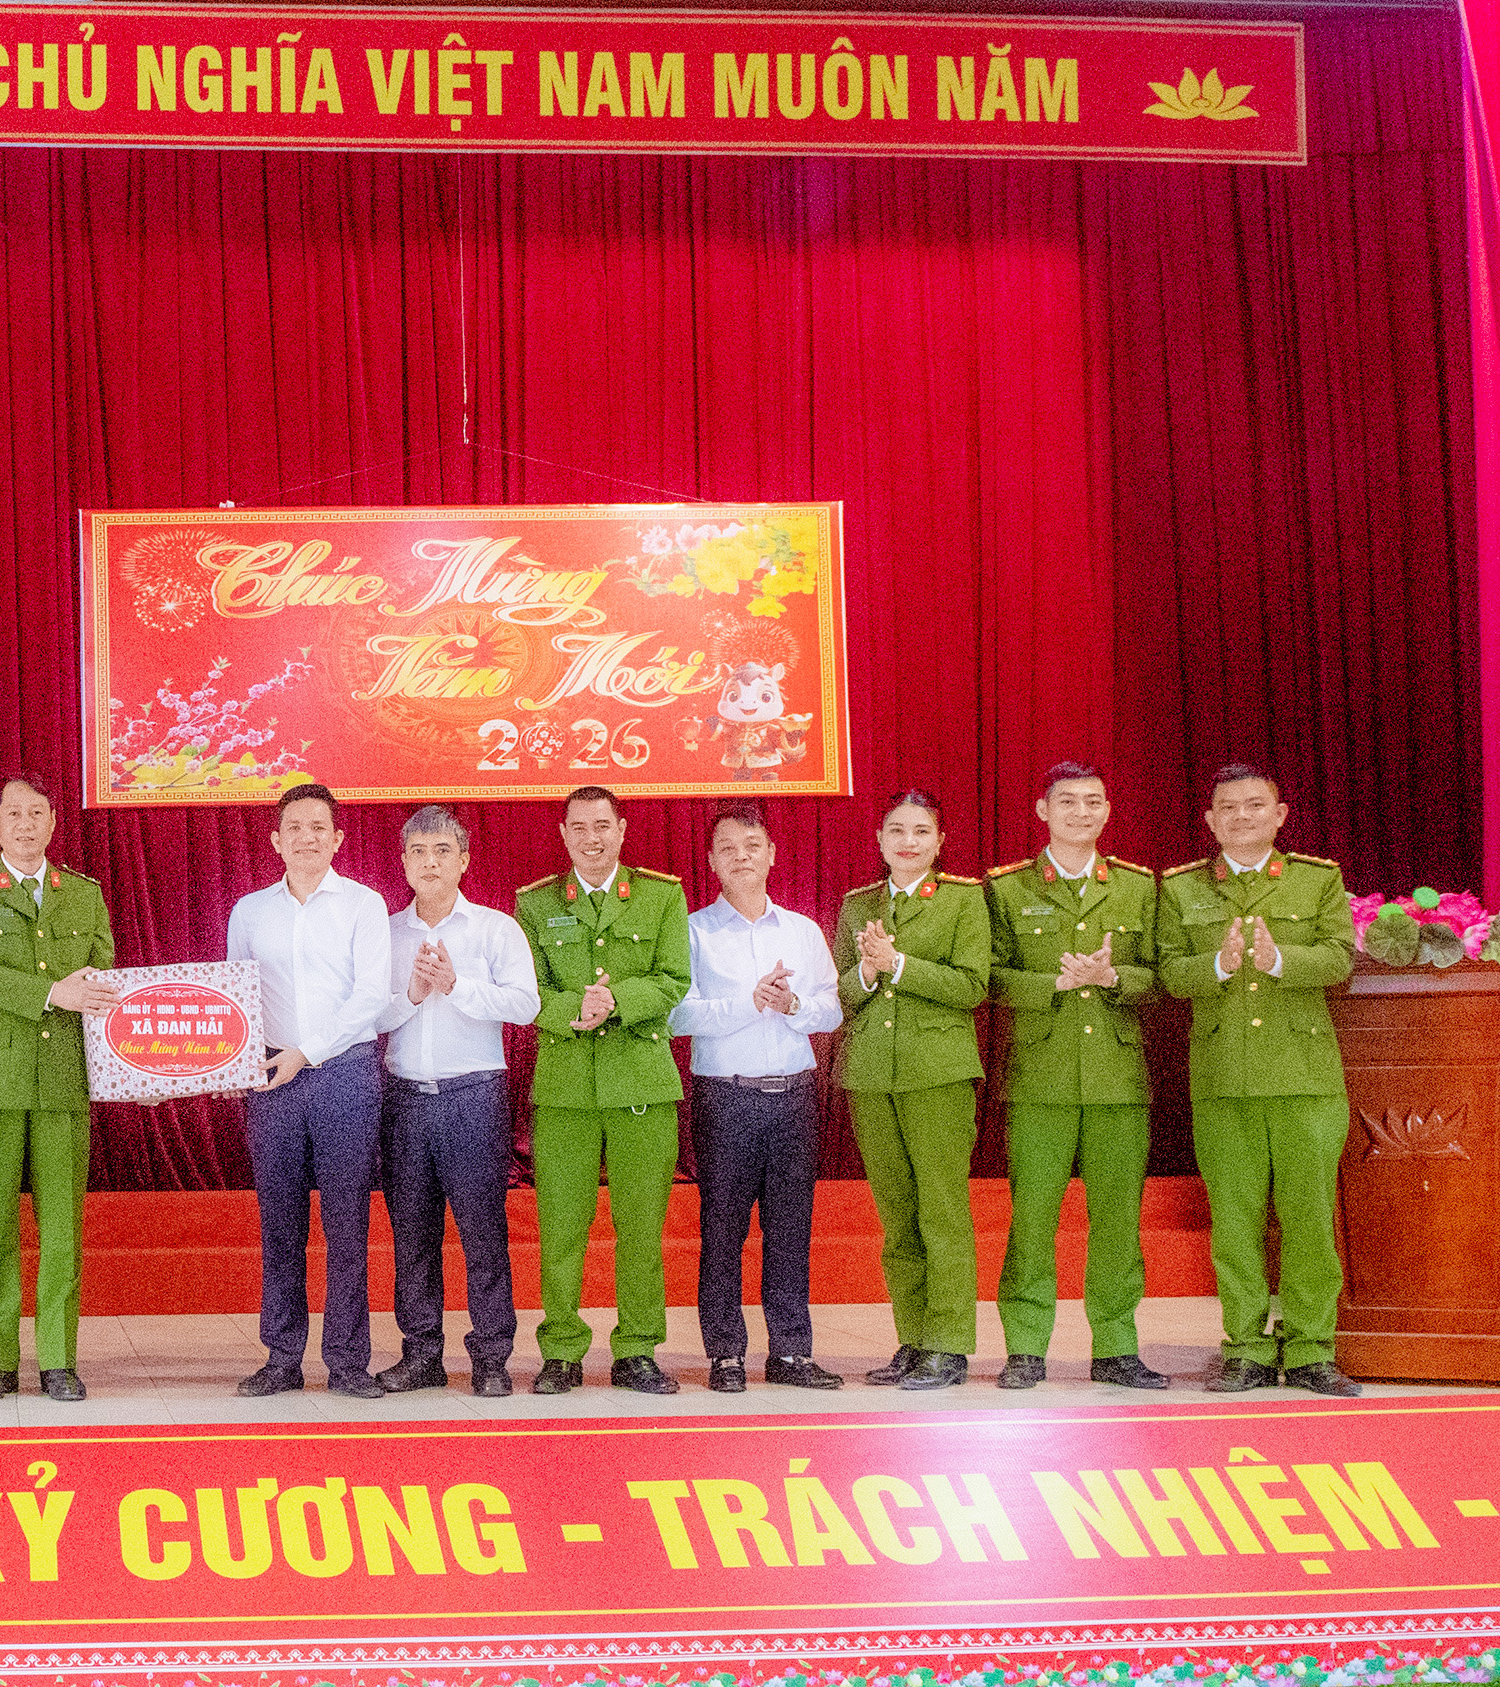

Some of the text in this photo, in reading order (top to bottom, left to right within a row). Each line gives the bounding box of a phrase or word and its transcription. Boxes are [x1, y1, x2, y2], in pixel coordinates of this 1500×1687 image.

[136, 32, 344, 114] NGHĨA
[365, 32, 514, 132] VIỆT
[539, 51, 685, 118] NAM
[713, 37, 909, 120] MUÔN
[936, 43, 1080, 123] NĂM
[196, 536, 610, 626] Chúc Mừng
[351, 630, 722, 710] Năm Mới
[119, 1040, 145, 1055] Chúc
[122, 1001, 140, 1014] ĐẢNG
[181, 1004, 199, 1014] UBND
[131, 1017, 223, 1035] XÃ ĐAN HẢI
[118, 1478, 528, 1581] CƯƠNG
[626, 1457, 1029, 1571] TRÁCH
[1030, 1446, 1441, 1575] NHIỆM
